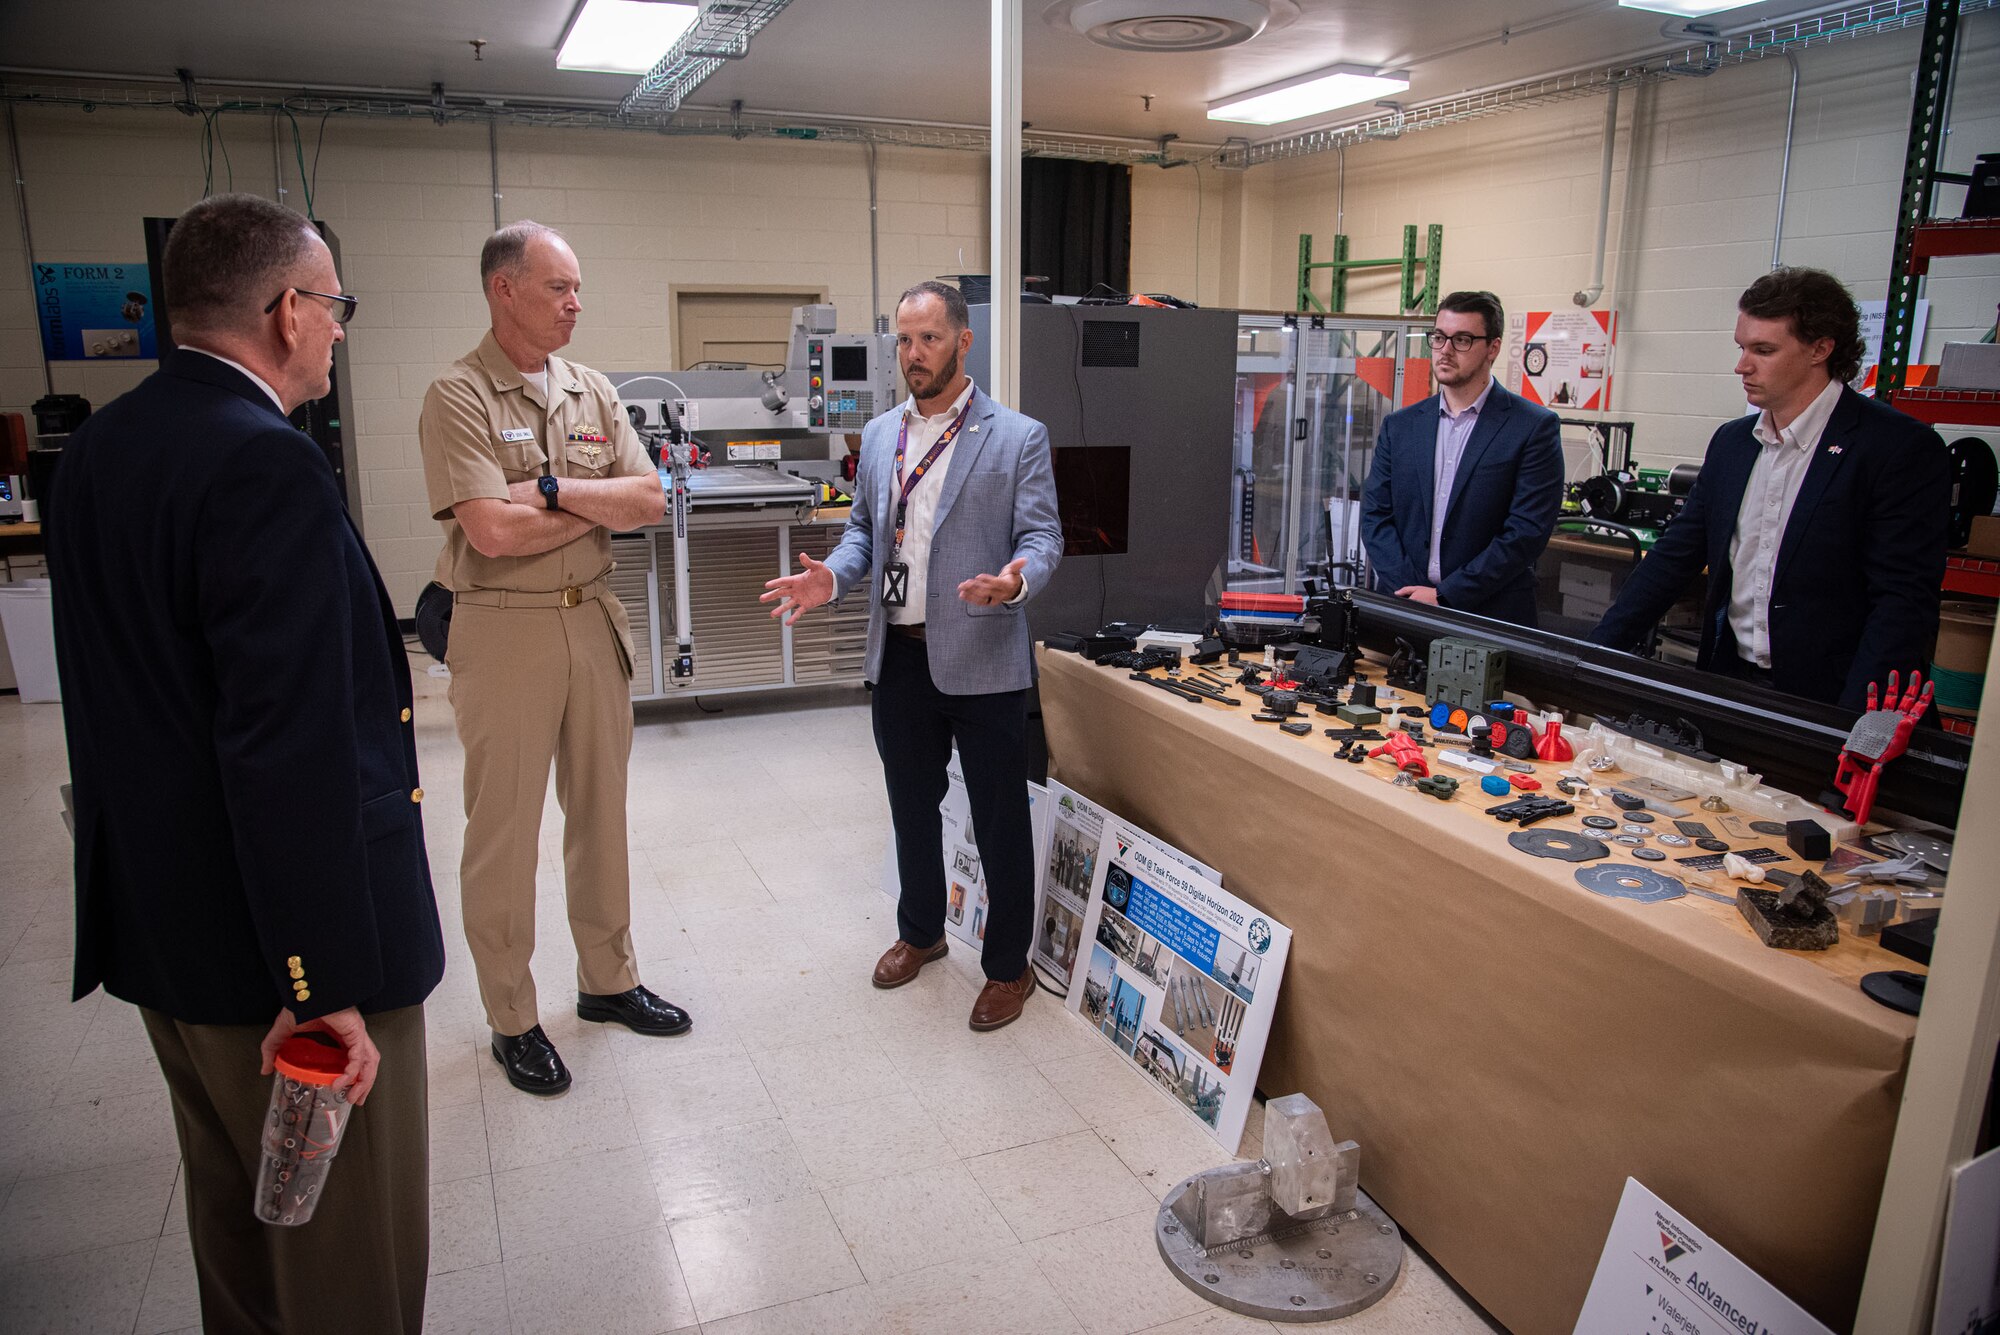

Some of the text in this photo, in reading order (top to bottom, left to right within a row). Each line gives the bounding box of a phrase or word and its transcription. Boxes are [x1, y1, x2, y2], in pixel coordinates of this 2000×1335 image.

[63, 267, 124, 279] FORM 2
[1510, 317, 1524, 359] ONE
[1134, 851, 1244, 926] ODM @ Task Force 59 Digital Horizon 2022
[1655, 1210, 1703, 1251] Naval Information
[1656, 1219, 1697, 1254] Warfare Center
[1648, 1255, 1682, 1284] ATLANTIC
[1658, 1294, 1700, 1335] Waterjets
[1686, 1271, 1759, 1335] Advanced
